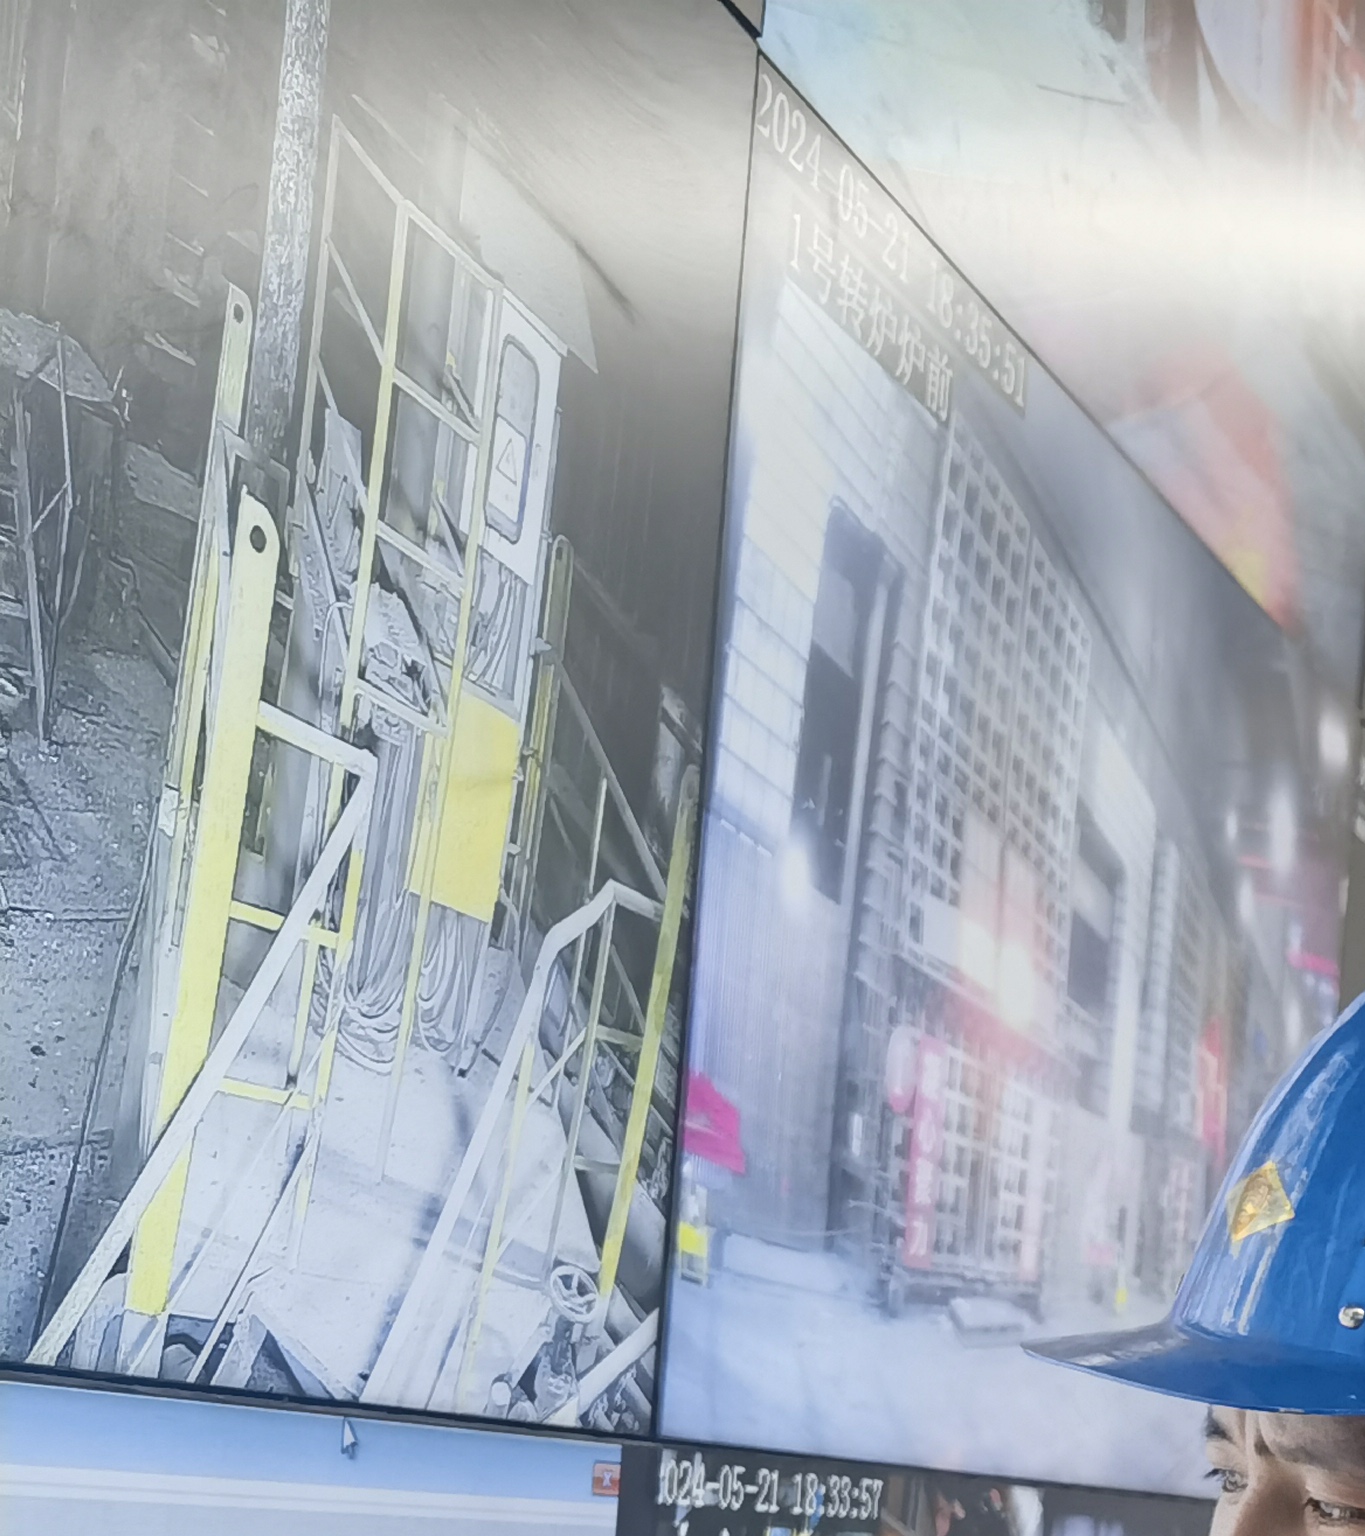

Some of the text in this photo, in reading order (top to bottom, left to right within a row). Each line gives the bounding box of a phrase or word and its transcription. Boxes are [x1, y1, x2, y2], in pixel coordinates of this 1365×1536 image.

[756, 73, 1026, 408] 2024-05-21 18:35:51
[790, 1472, 884, 1520] 18:33:57
